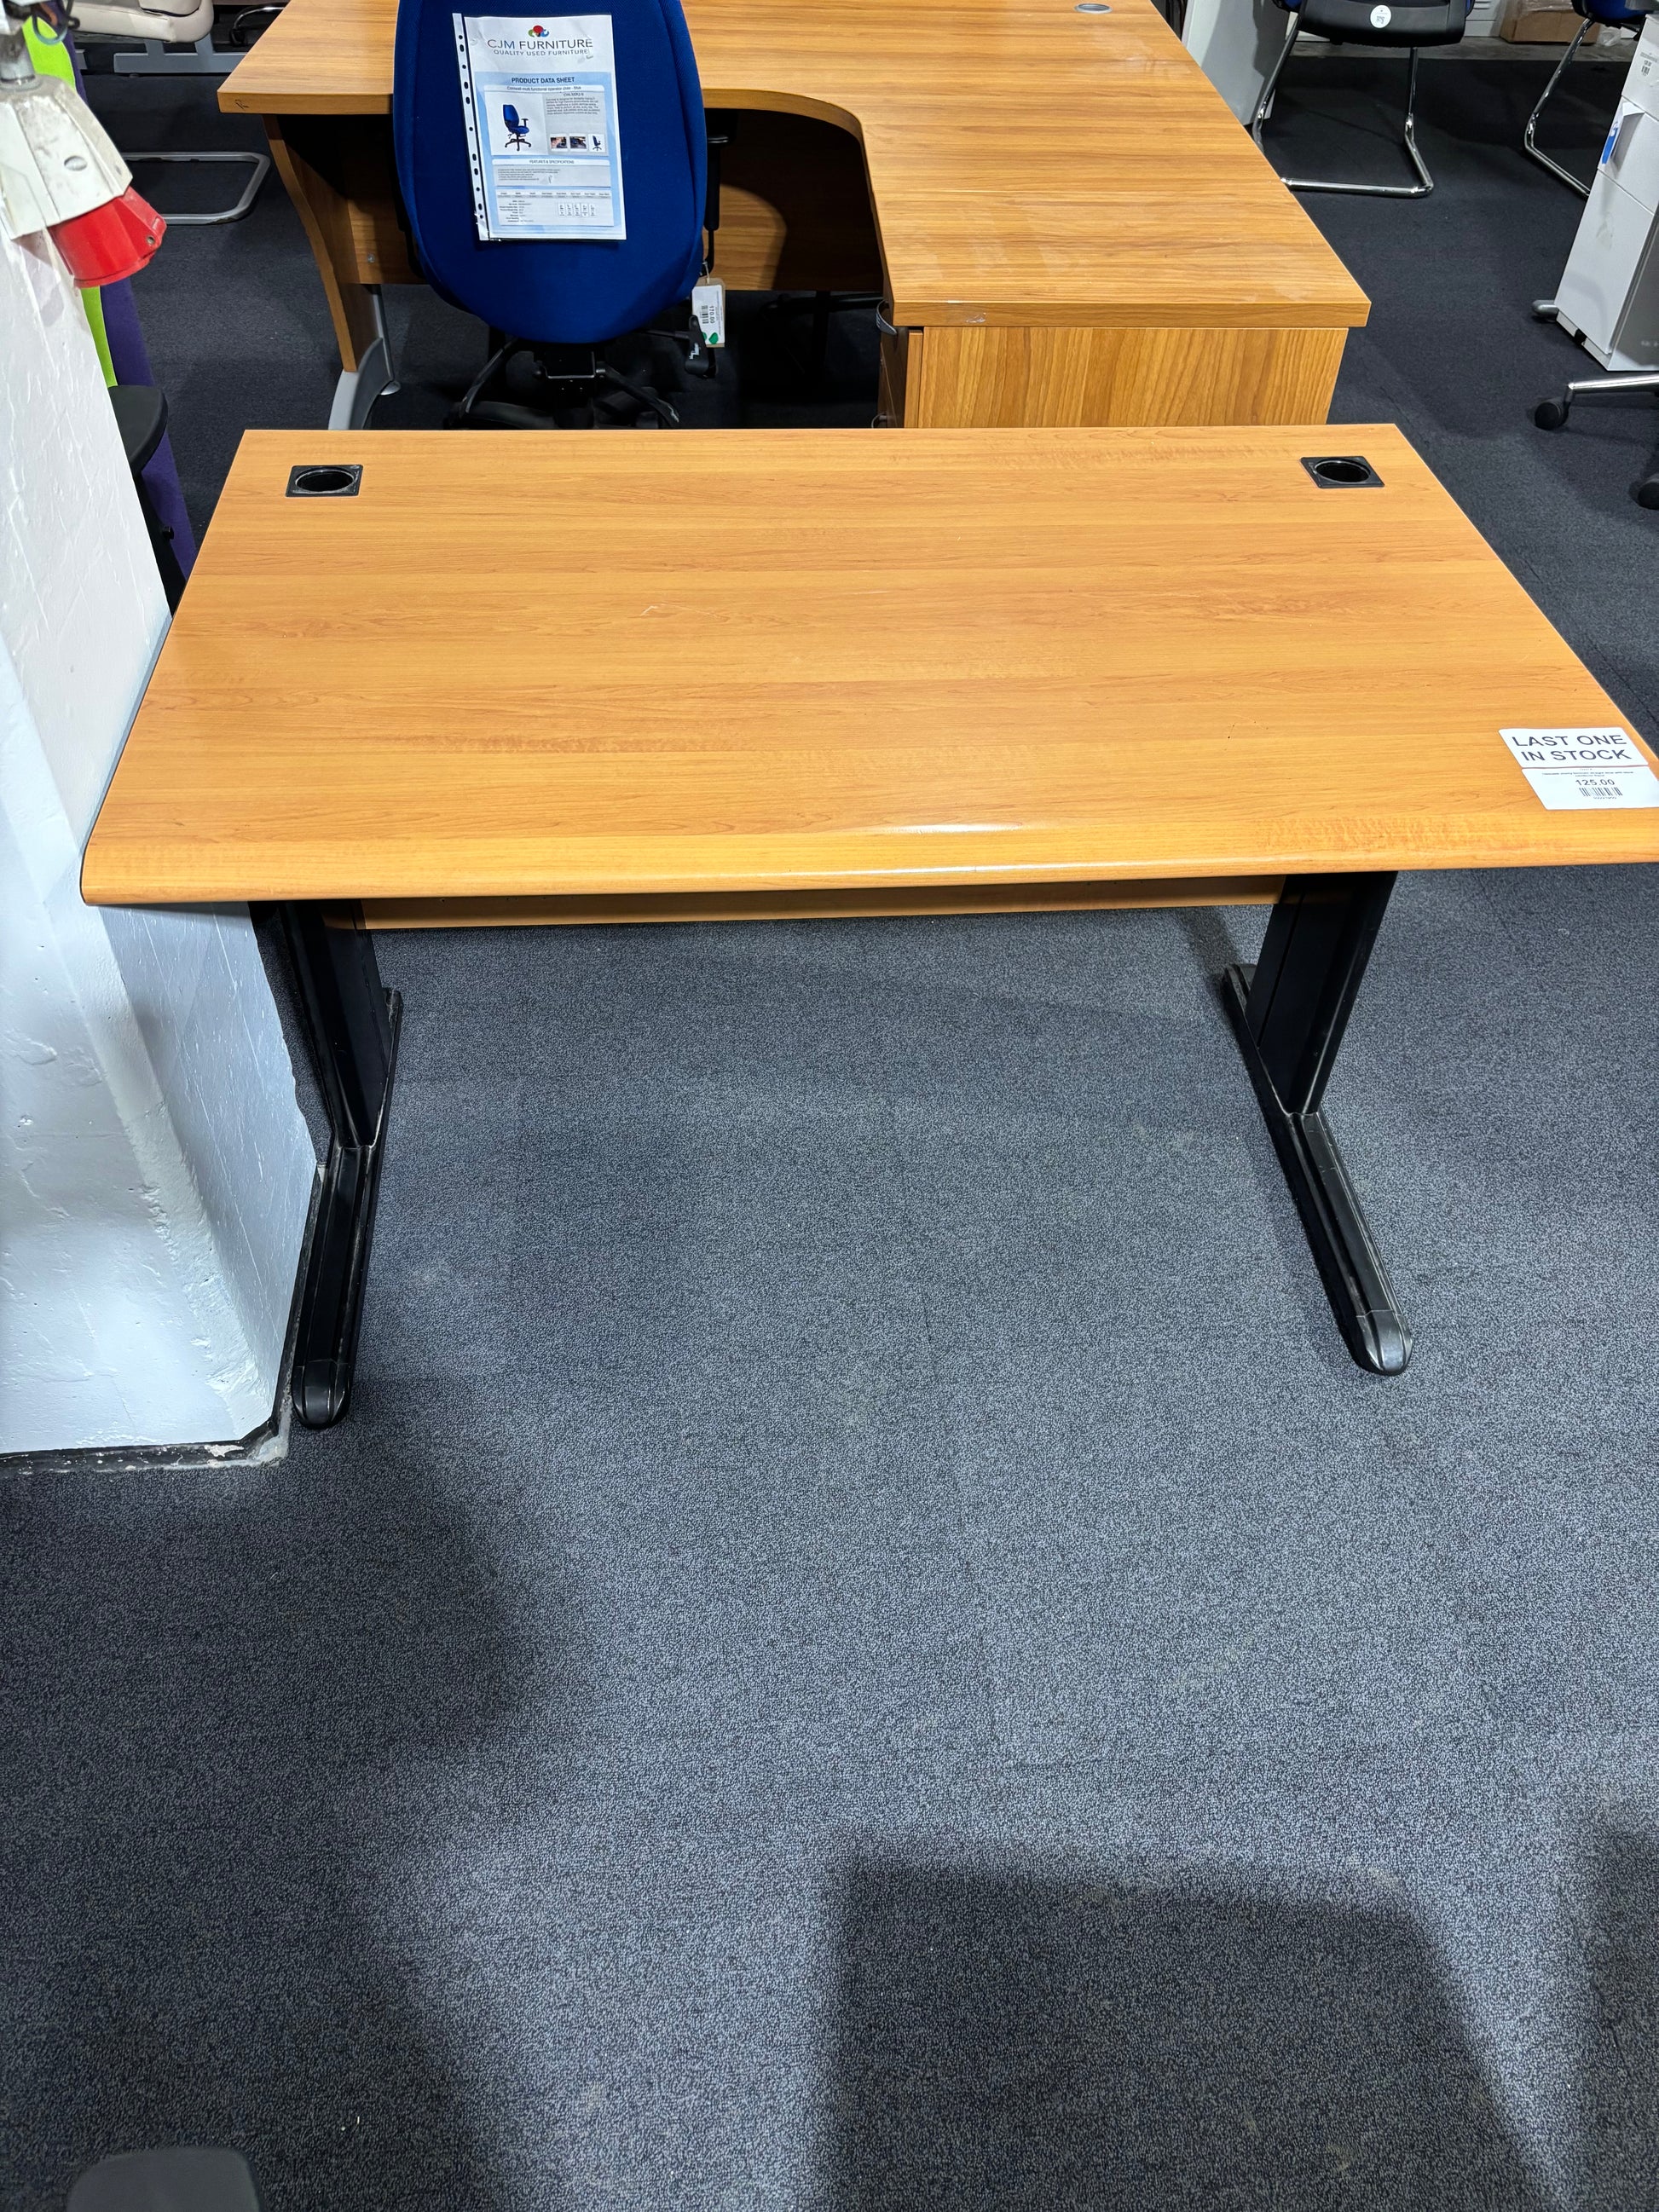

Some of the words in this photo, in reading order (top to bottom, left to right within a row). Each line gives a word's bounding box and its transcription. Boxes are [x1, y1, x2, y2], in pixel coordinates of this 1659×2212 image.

[487, 39, 515, 49] CJM
[519, 39, 593, 49] FURNITURE
[1512, 736, 1569, 746] LAST
[1576, 735, 1627, 745] ONE
[1520, 751, 1546, 761] IN
[1550, 749, 1633, 760] STOCK
